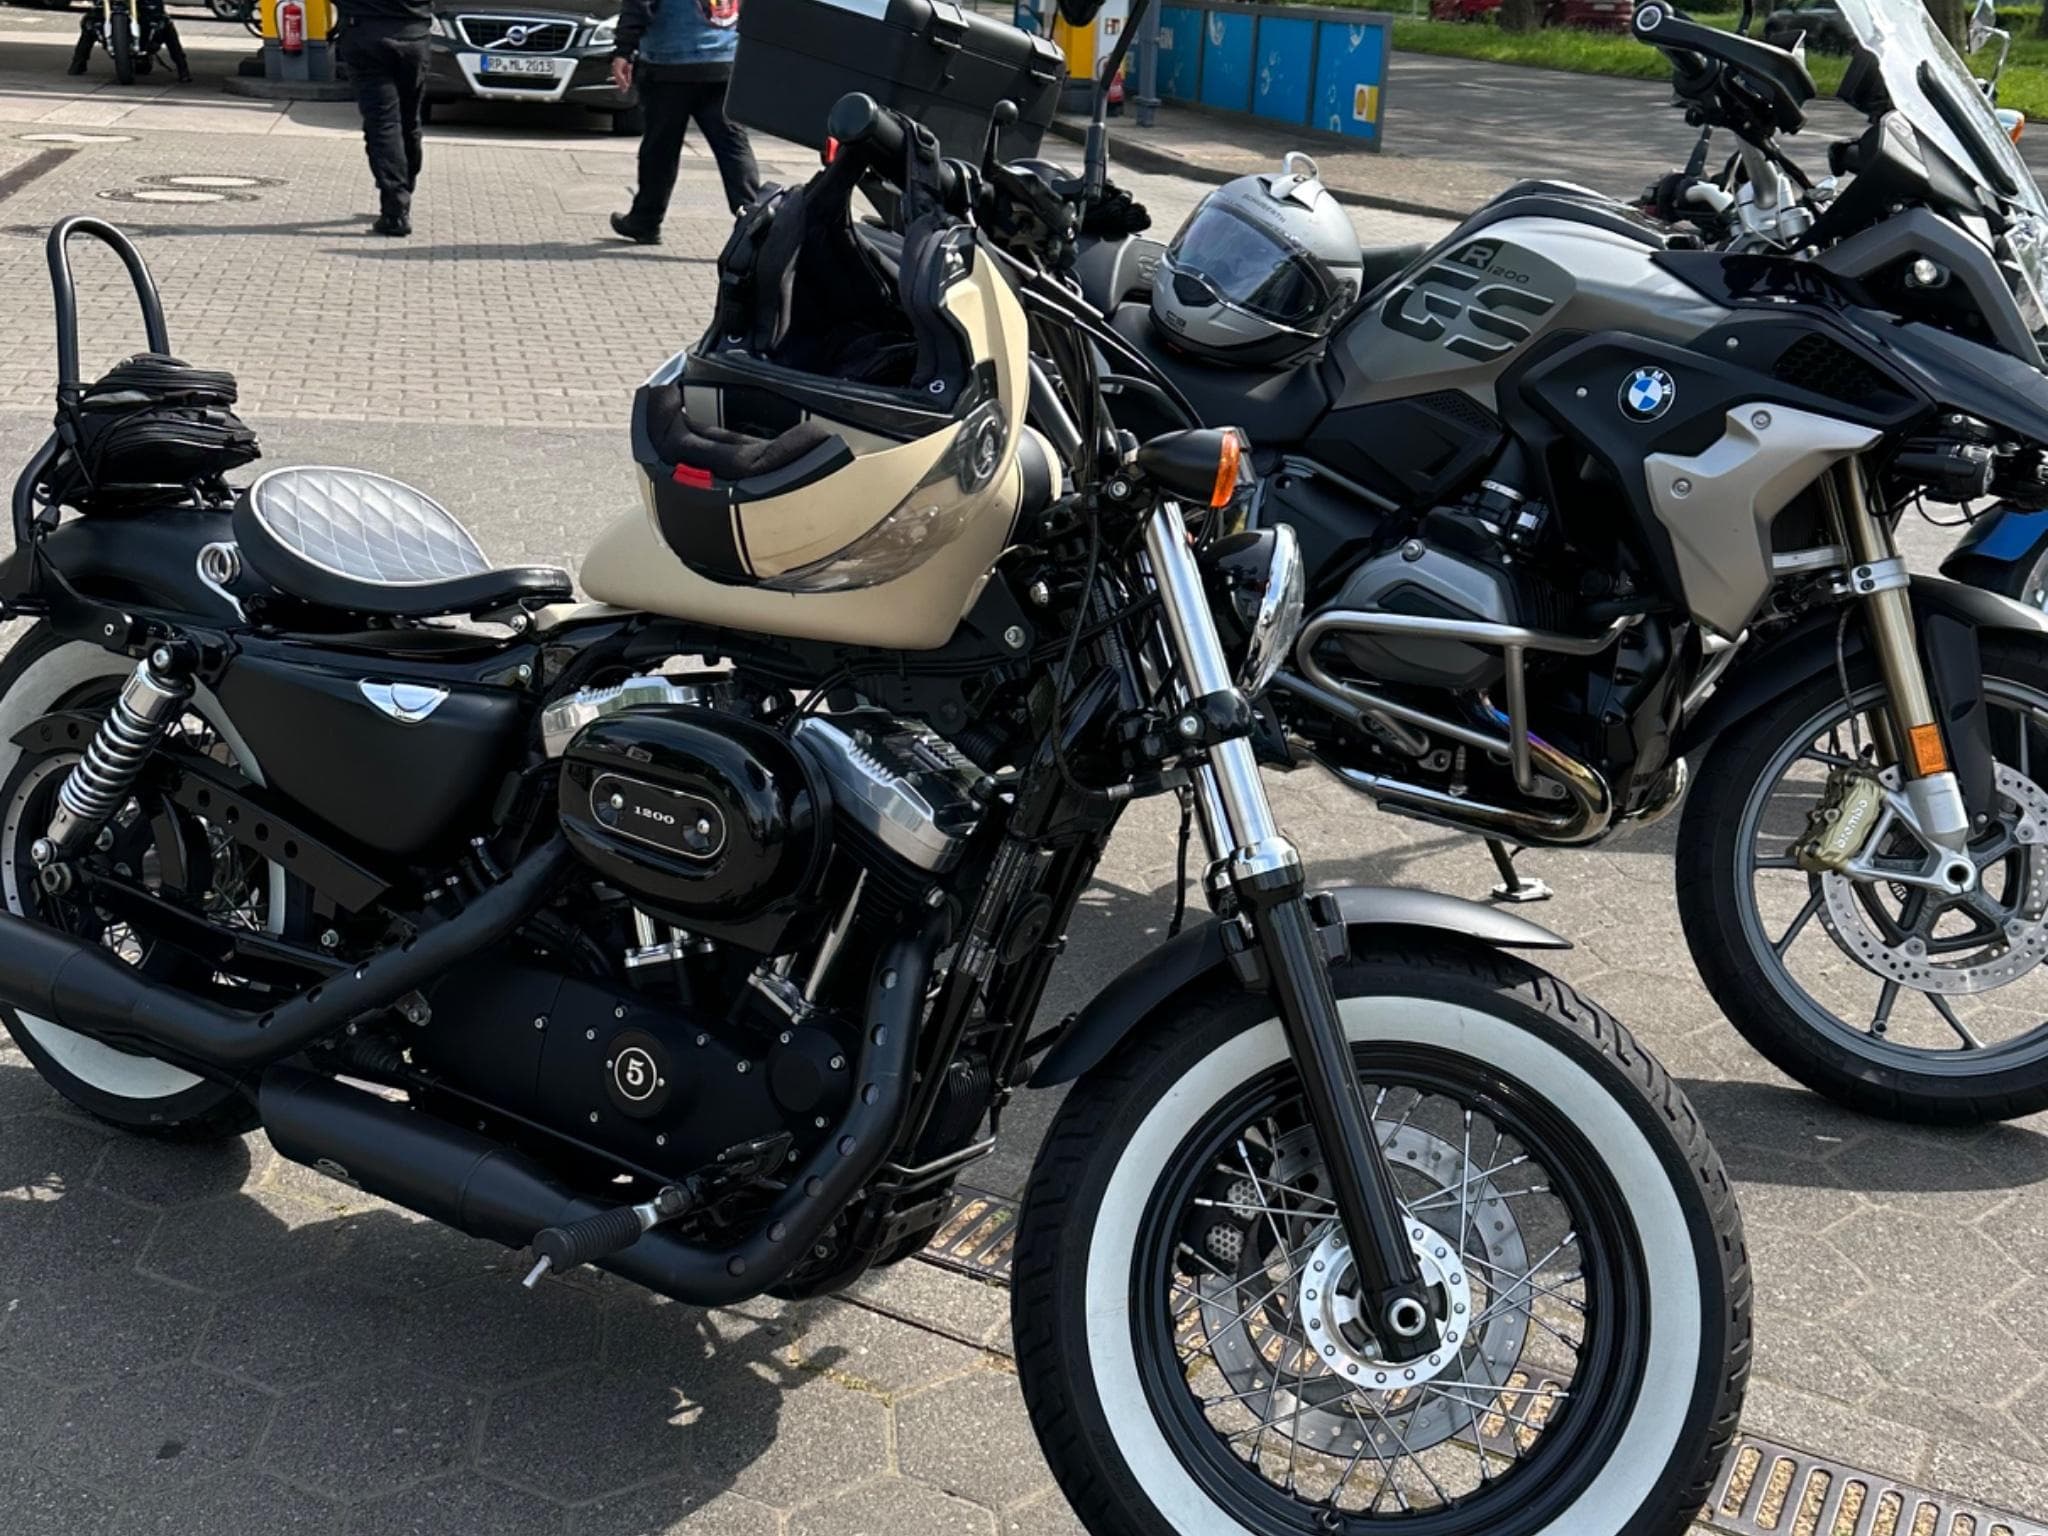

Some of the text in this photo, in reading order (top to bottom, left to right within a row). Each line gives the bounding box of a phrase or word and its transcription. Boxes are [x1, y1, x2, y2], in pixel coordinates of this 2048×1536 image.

[1460, 244, 1530, 285] R 1200
[1380, 263, 1555, 362] GS
[1635, 369, 1673, 395] BMW
[634, 806, 676, 825] 1200
[1832, 799, 1868, 849] brembo
[626, 1057, 645, 1086] 5
